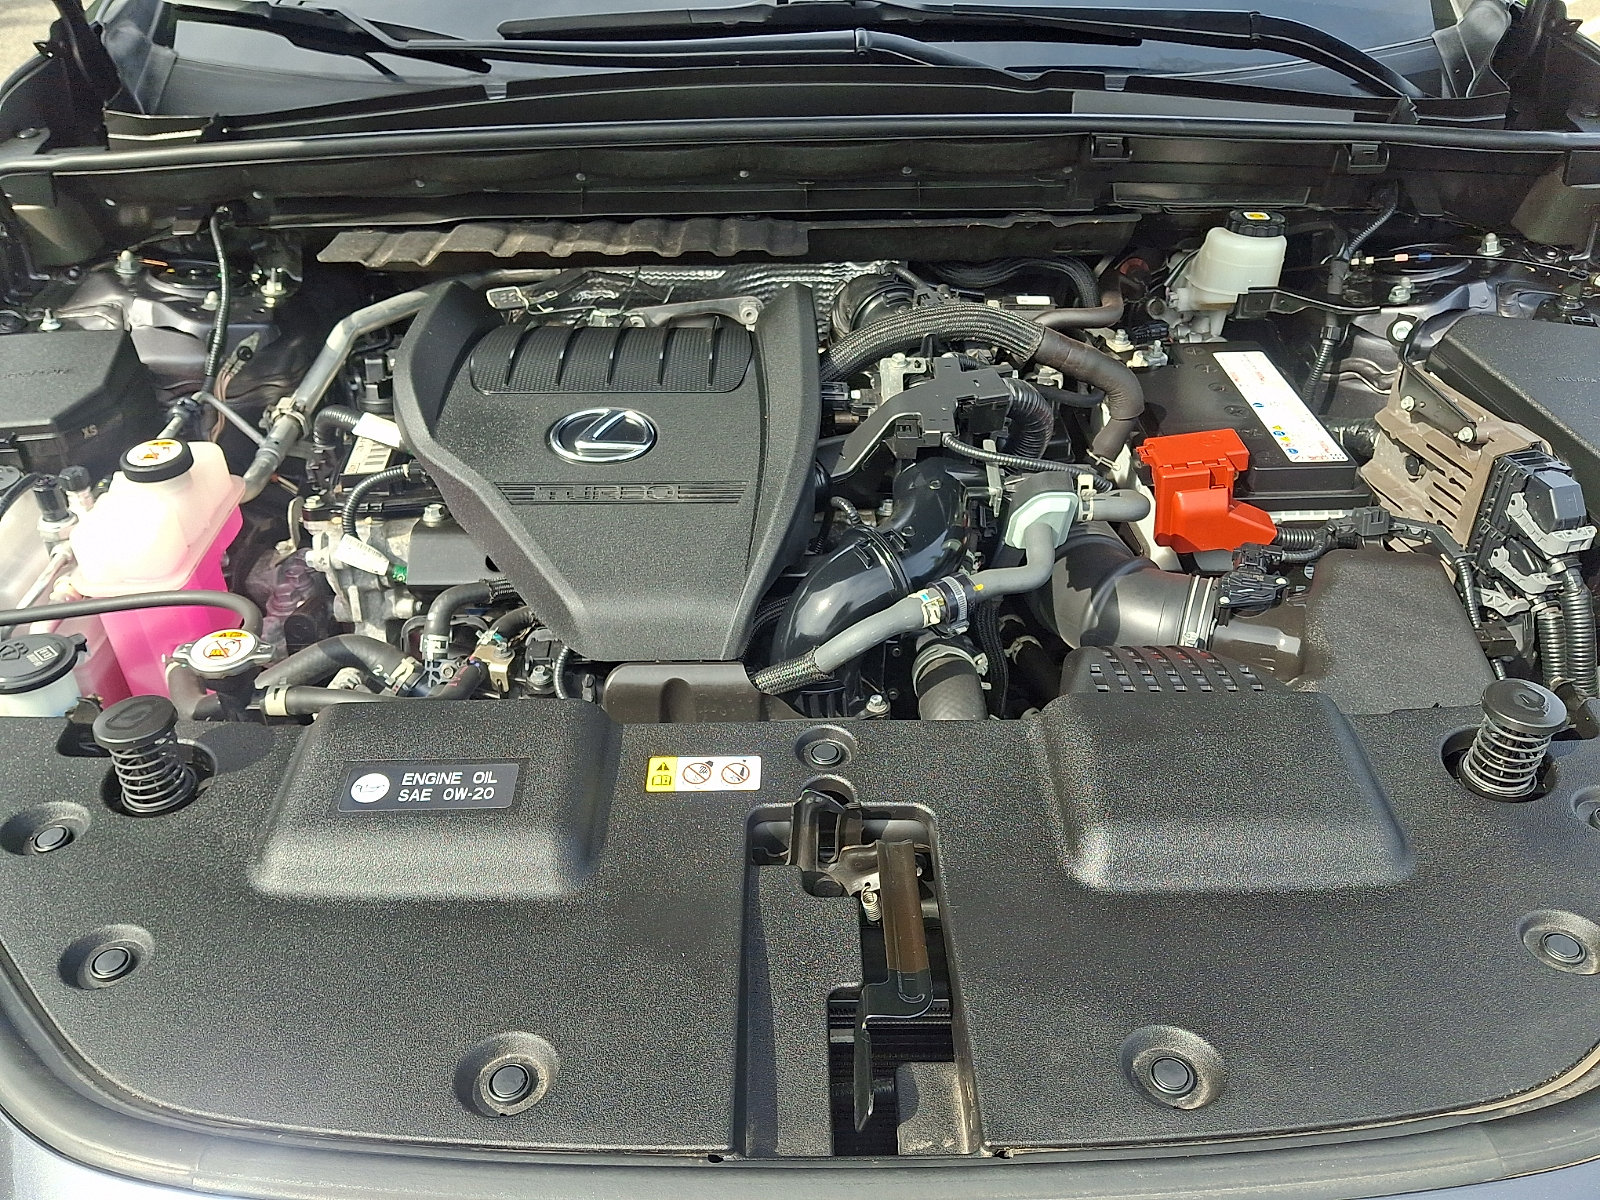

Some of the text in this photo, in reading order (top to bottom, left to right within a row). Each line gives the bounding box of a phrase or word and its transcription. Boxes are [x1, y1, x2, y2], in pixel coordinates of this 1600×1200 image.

[538, 485, 675, 500] TURBO
[401, 771, 498, 785] ENGINE OIL
[398, 787, 495, 802] SAE 0W-20
